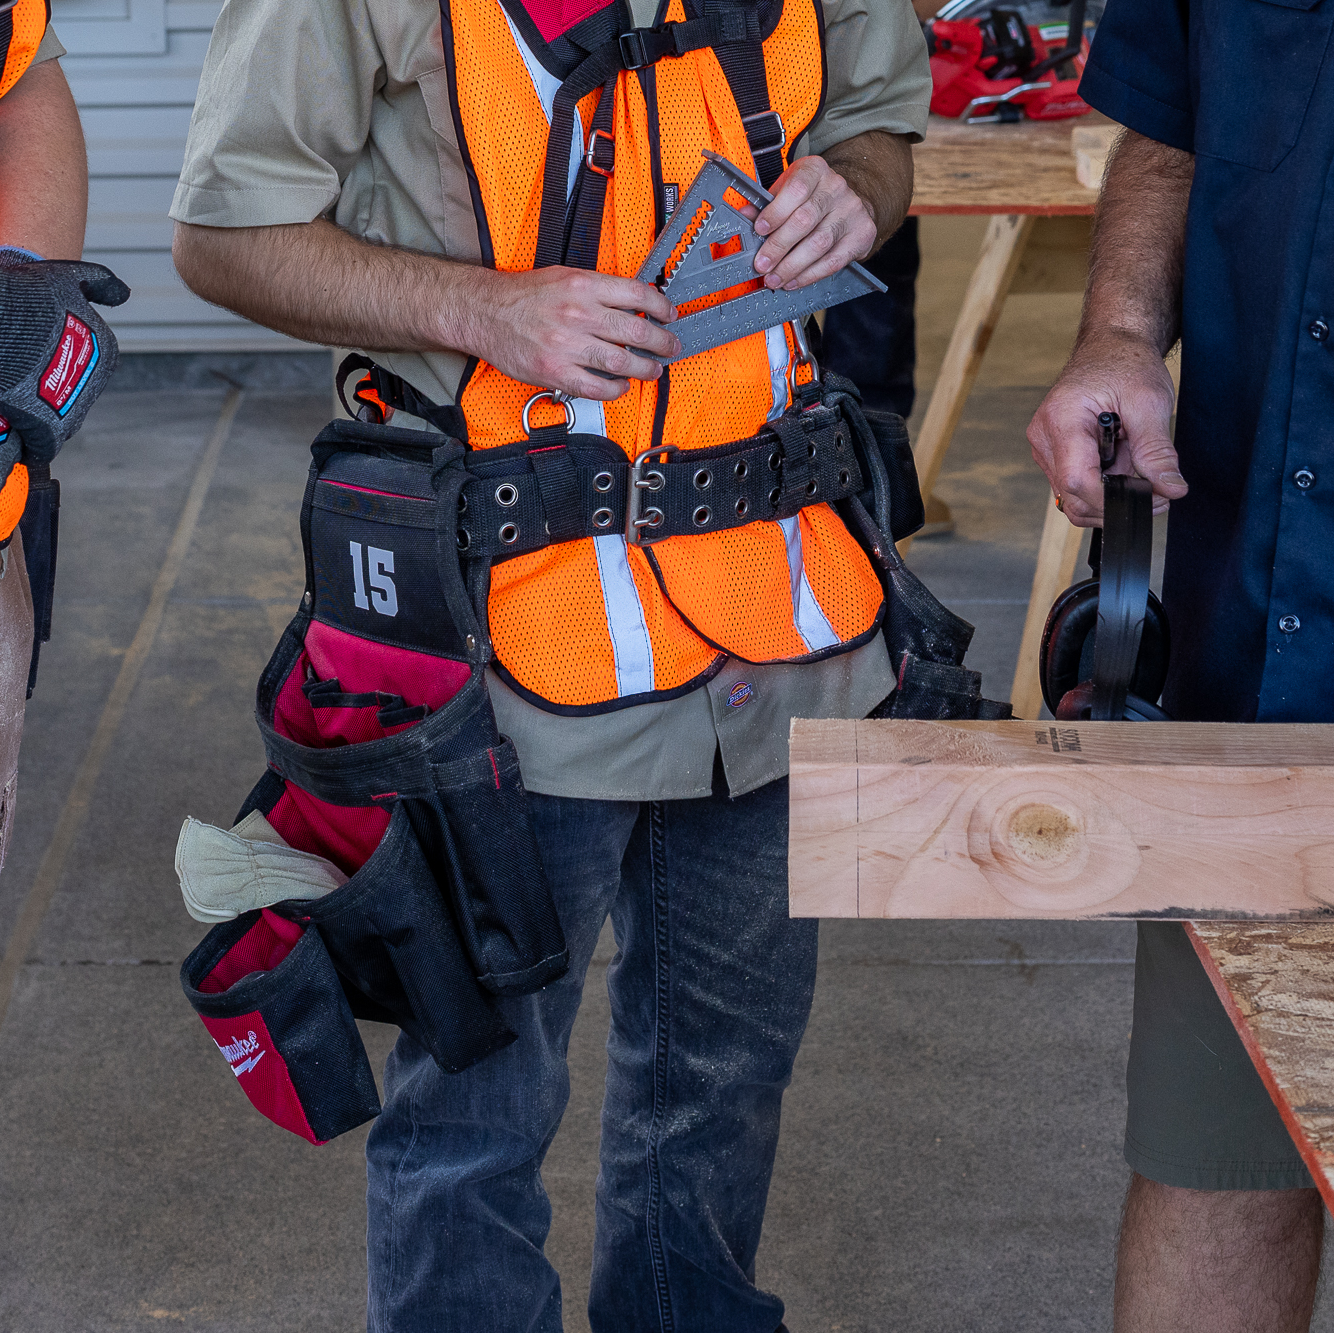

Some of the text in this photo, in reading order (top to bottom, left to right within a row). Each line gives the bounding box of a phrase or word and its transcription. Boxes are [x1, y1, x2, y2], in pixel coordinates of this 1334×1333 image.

[665, 187, 675, 212] WORKS
[45, 334, 72, 391] Milwaukee
[349, 540, 399, 617] 15
